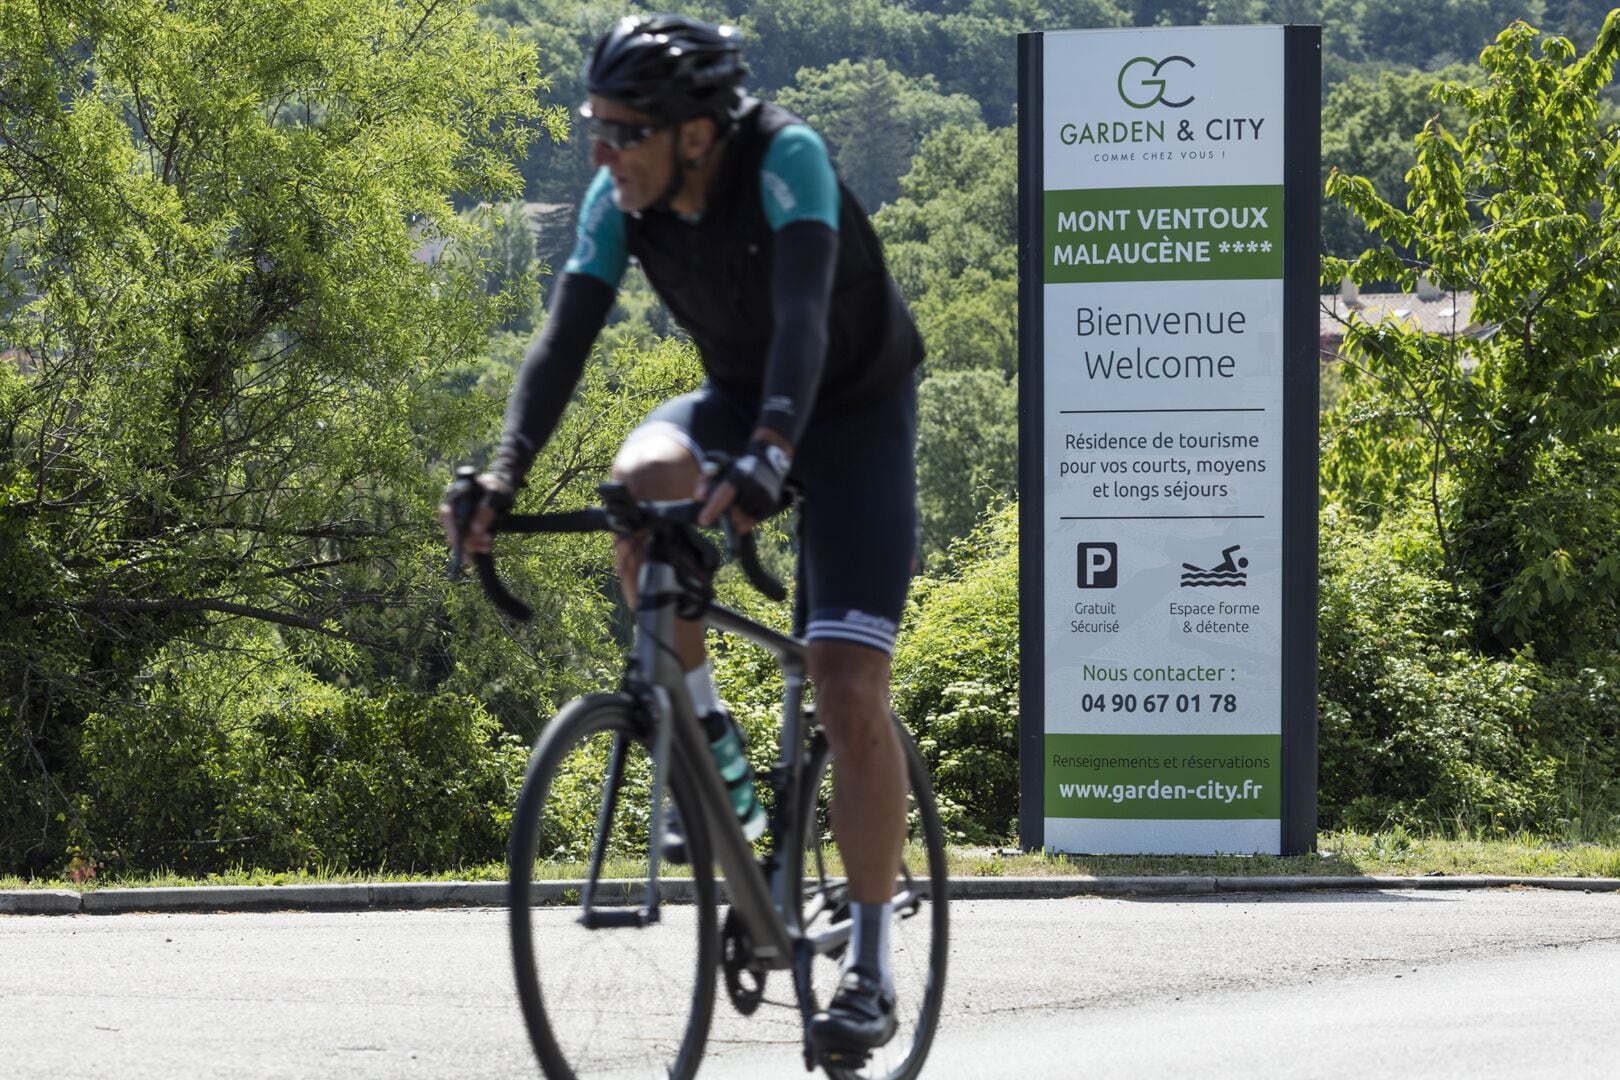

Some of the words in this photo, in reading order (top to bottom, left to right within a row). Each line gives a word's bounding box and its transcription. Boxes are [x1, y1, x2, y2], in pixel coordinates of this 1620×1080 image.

[1117, 55, 1196, 110] GC
[1059, 119, 1165, 146] GARDEN
[1176, 119, 1195, 142] &
[1205, 117, 1265, 141] CITY
[1093, 152, 1135, 163] COMME
[1142, 151, 1173, 161] CHEZ
[1180, 150, 1214, 160] VOUS
[1057, 209, 1131, 233] MONT
[1136, 206, 1269, 231] VENTOUX
[1053, 234, 1211, 266] MALAUCÈNE
[1077, 306, 1246, 337] Bienvenue
[1084, 346, 1236, 380] Welcome
[1065, 432, 1148, 450] Résidence
[1152, 431, 1174, 449] de
[1179, 431, 1259, 449] tourisme
[1059, 461, 1097, 478] pour
[1100, 460, 1128, 474] vos
[1132, 457, 1191, 476] courts,
[1196, 459, 1266, 477] moyens
[1092, 482, 1110, 498] et
[1114, 480, 1160, 502] longs
[1163, 480, 1228, 501] séjours
[1086, 547, 1112, 586] P
[1074, 601, 1117, 615] Gratuit
[1169, 602, 1216, 618] Espace
[1218, 601, 1260, 615] forme
[1070, 619, 1120, 633] Sécurisé
[1182, 620, 1193, 634] &
[1195, 619, 1250, 634] détente
[1083, 664, 1128, 682] Nous
[1133, 664, 1226, 682] contacter
[1081, 693, 1107, 713] 04
[1111, 693, 1138, 713] 90
[1143, 694, 1170, 713] 67
[1175, 693, 1200, 713] 01
[1209, 693, 1237, 713] 78
[1053, 754, 1161, 771] Renseignements
[1162, 755, 1179, 769] et
[1181, 754, 1271, 769] réservations
[1059, 779, 1263, 802] www.garden-city.fr
